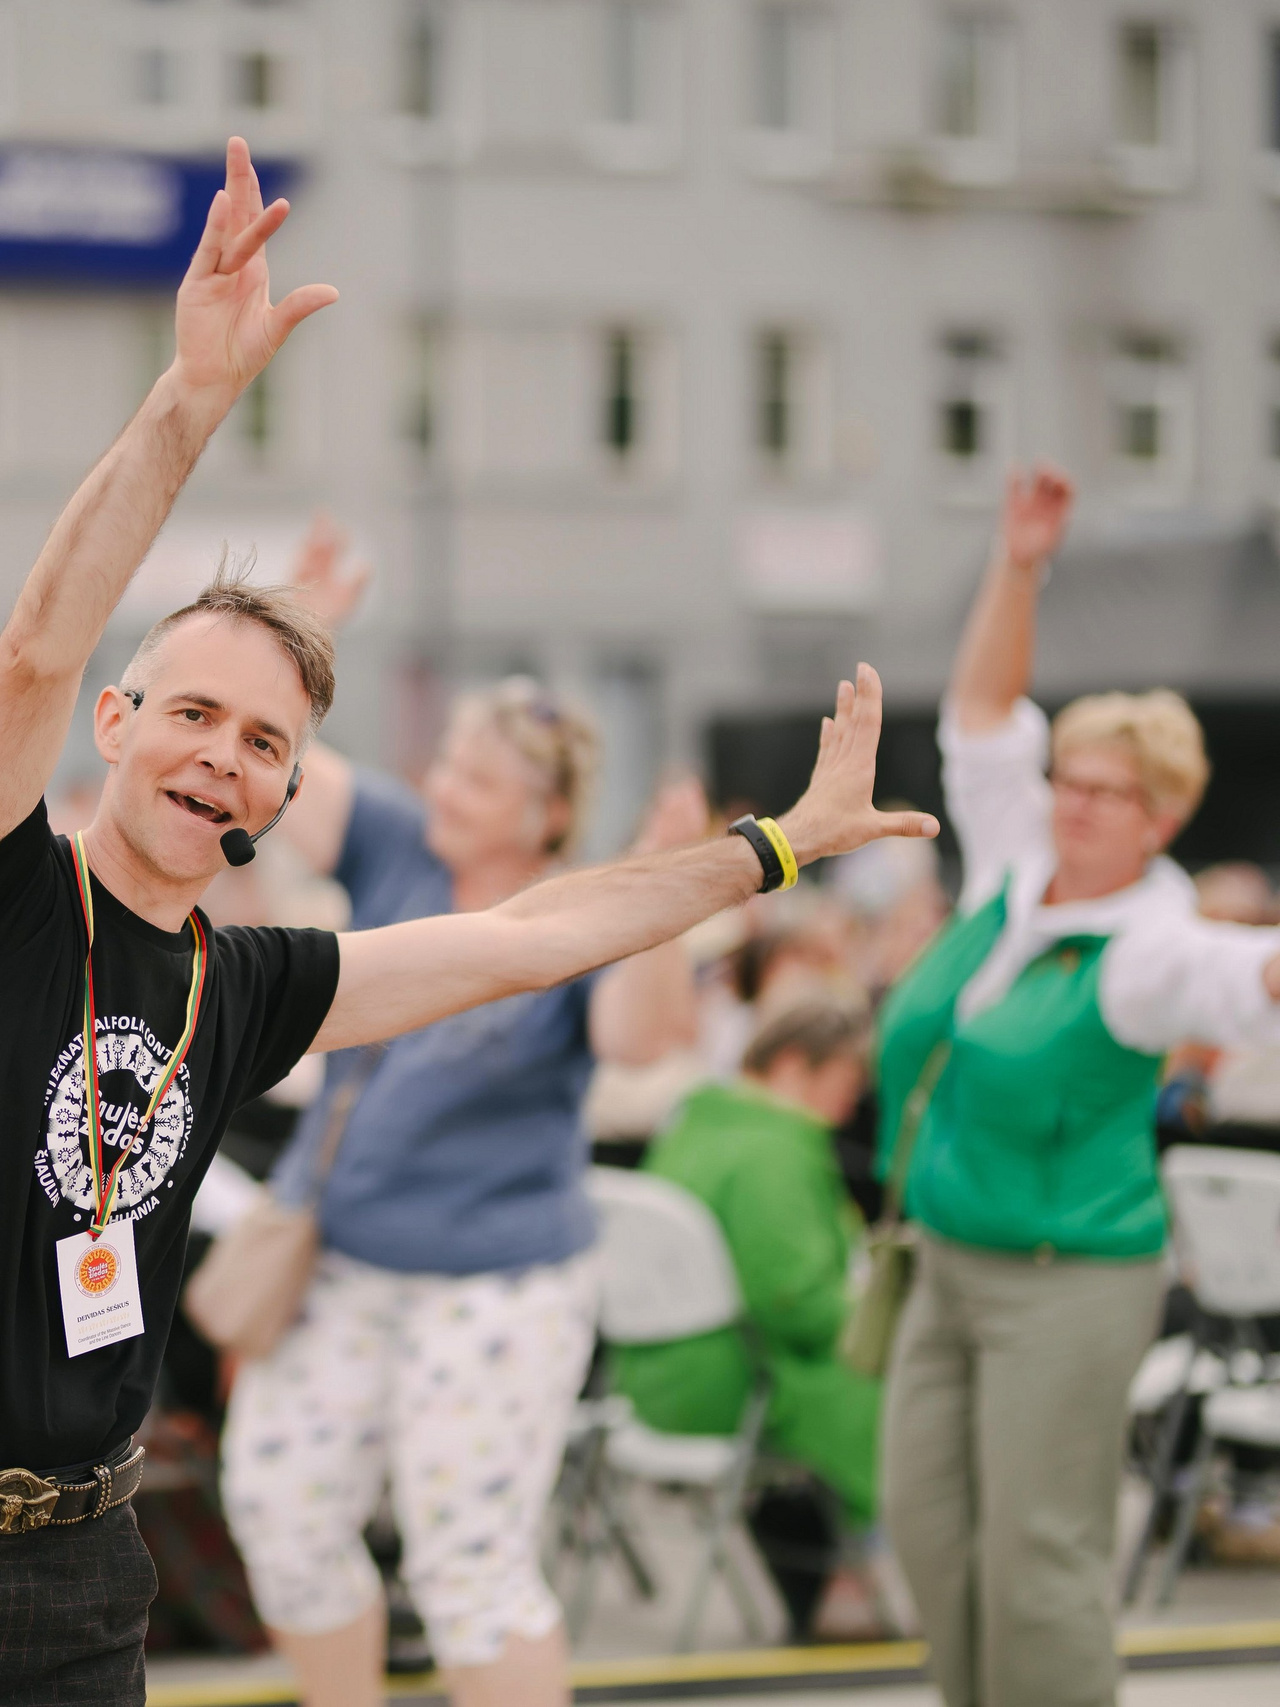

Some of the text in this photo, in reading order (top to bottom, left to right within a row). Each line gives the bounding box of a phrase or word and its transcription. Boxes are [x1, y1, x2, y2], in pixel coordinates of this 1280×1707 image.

[43, 1015, 110, 1106] TERNATAL
[111, 1015, 146, 1034] FOLK
[83, 1089, 150, 1133] aulės
[90, 1195, 161, 1228] LHUANIA
[77, 1309, 106, 1323] DEIVIDAS
